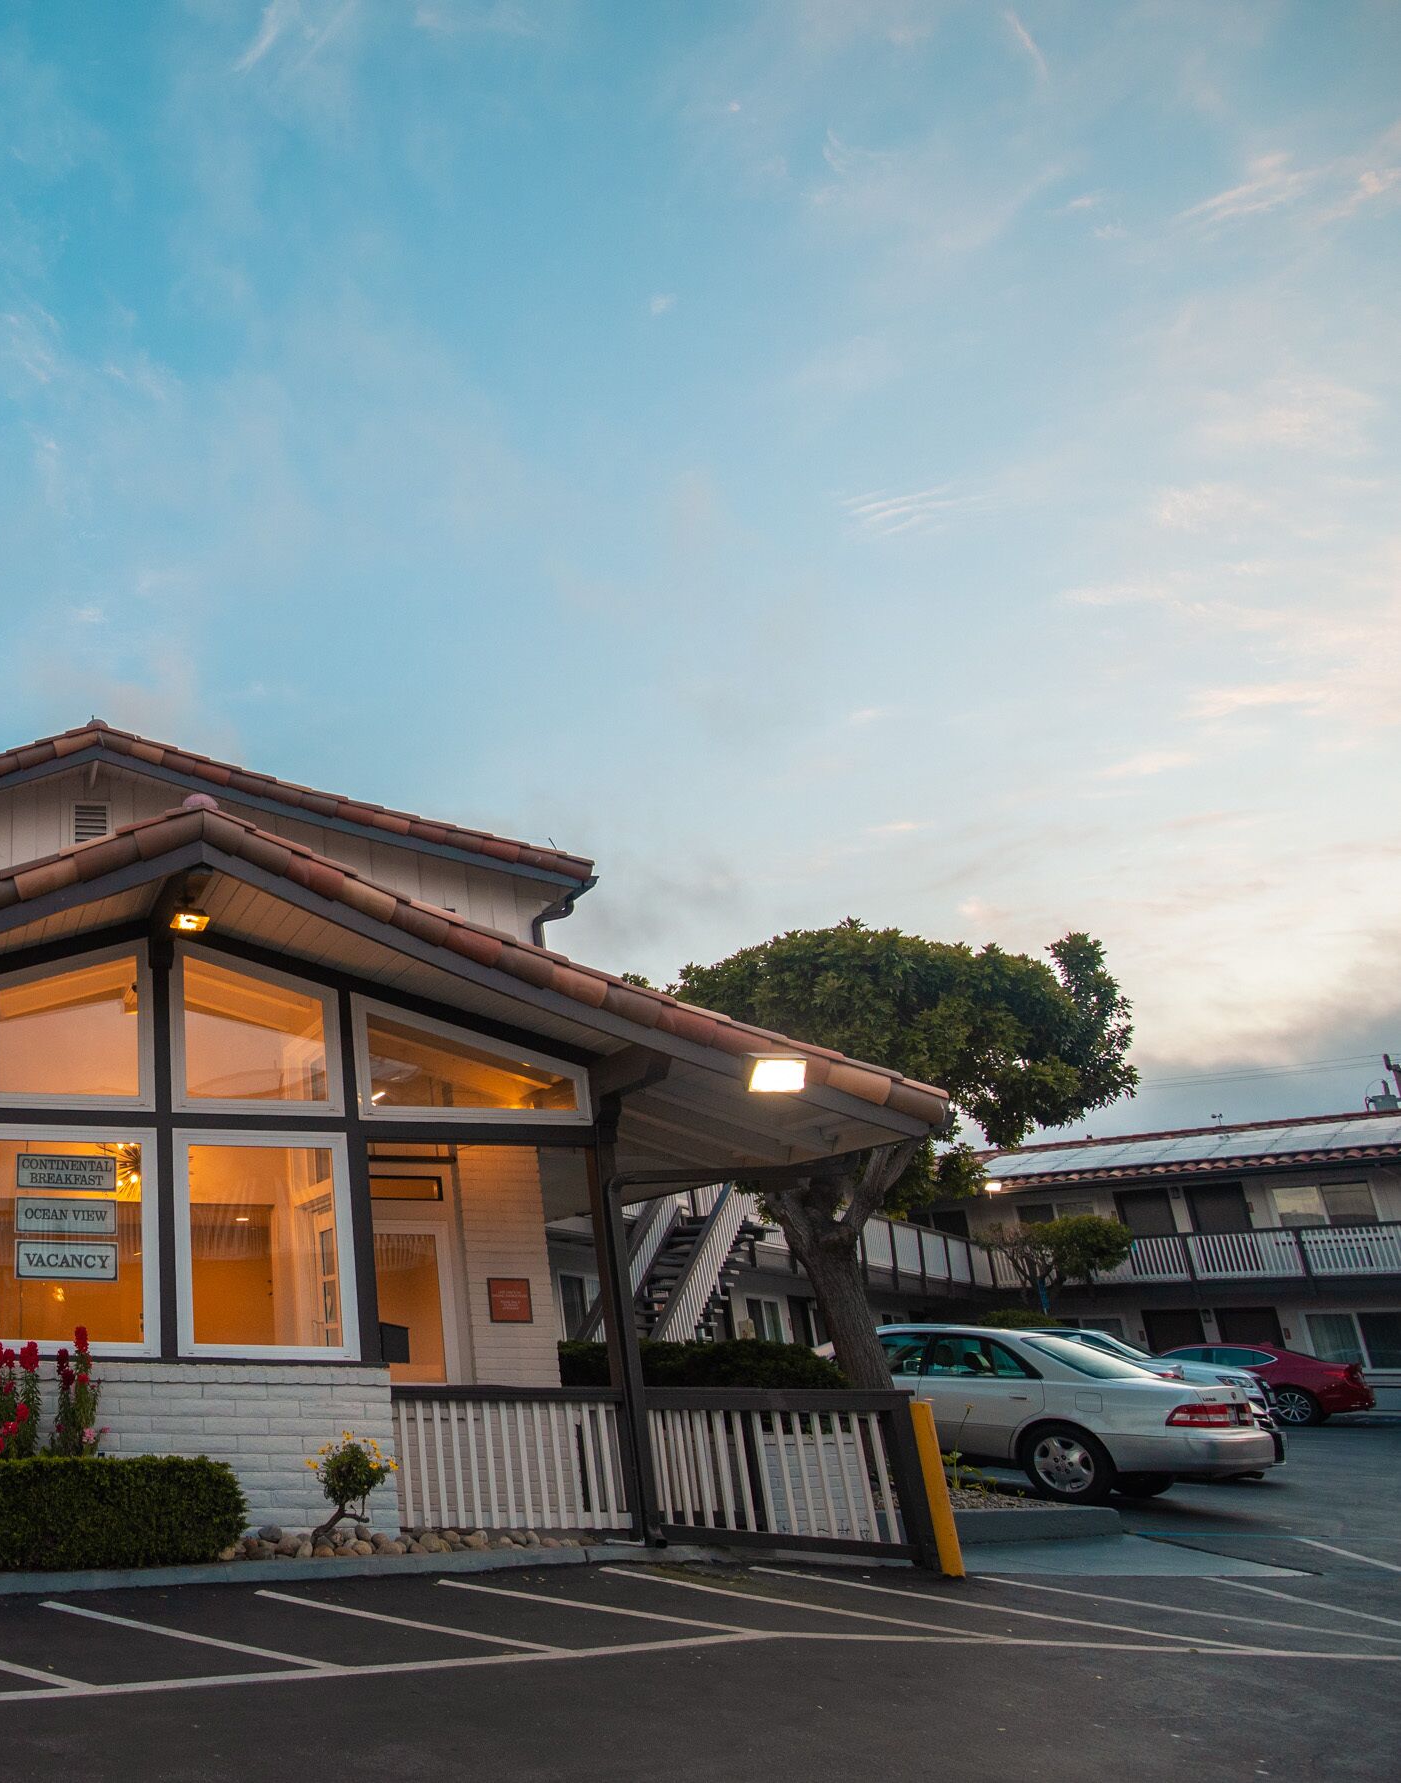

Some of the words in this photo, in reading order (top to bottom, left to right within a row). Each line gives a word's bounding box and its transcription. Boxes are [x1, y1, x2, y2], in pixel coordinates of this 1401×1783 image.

[22, 1159, 112, 1172] CONTINENTAL
[30, 1173, 103, 1186] BREAKFAST
[24, 1208, 69, 1220] OCEAN
[72, 1210, 108, 1222] VIEW
[24, 1253, 110, 1269] VACANCY
